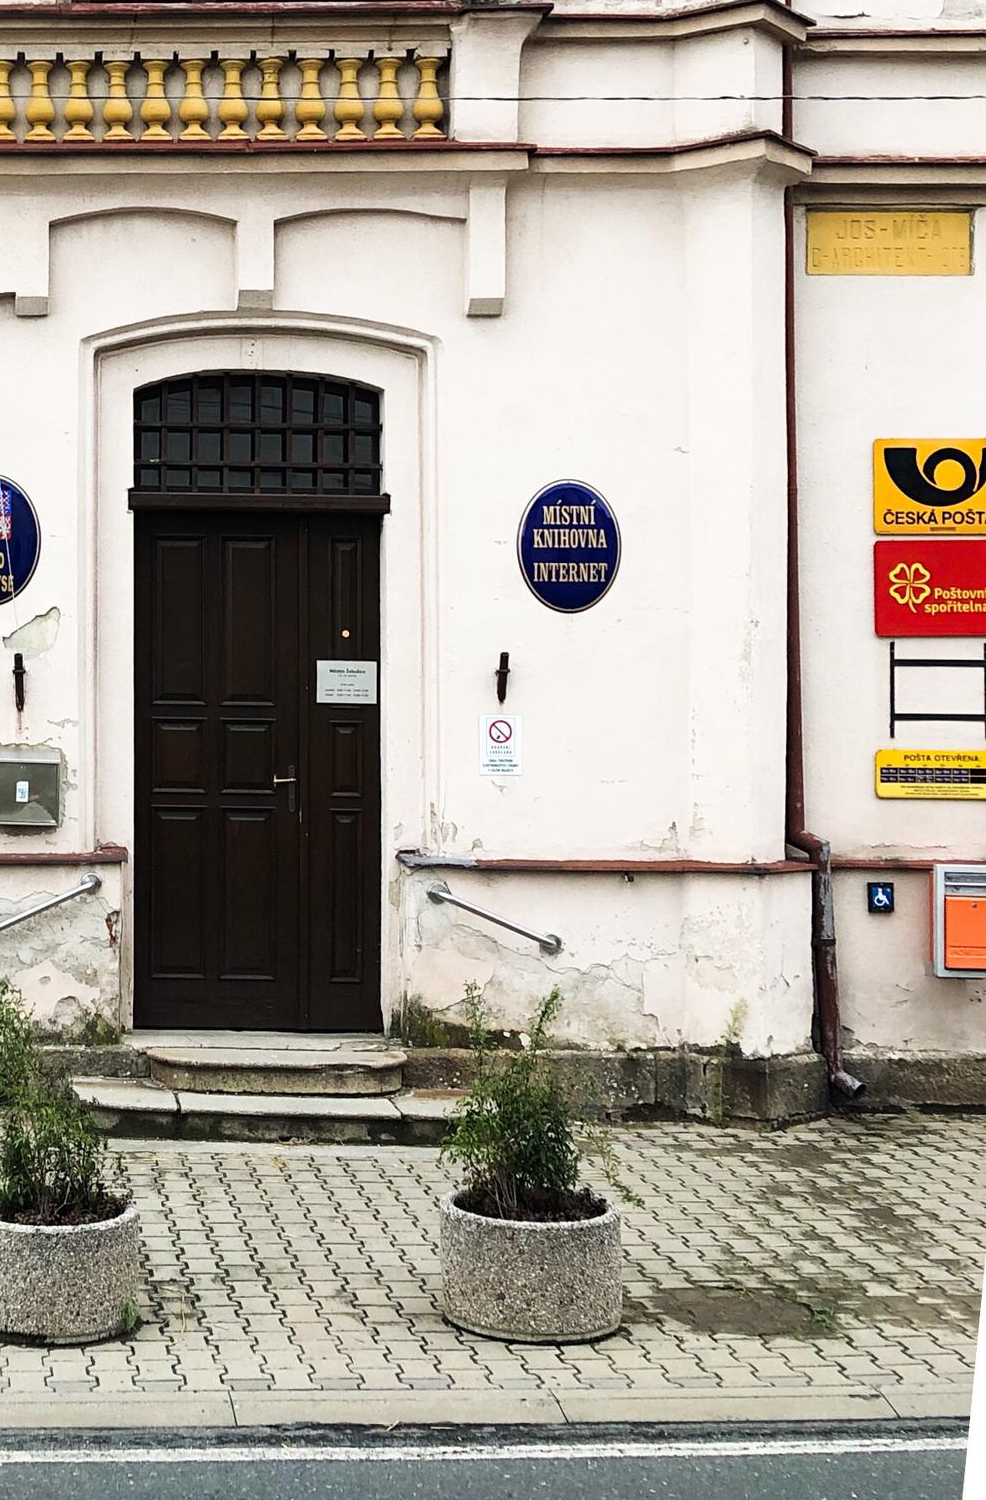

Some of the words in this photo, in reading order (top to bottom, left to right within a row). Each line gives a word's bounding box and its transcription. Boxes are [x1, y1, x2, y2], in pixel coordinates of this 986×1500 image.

[542, 499, 596, 525] MÍSTNÍ
[883, 508, 938, 525] ČESKÁ
[941, 508, 986, 525] POŠT
[533, 528, 608, 549] KNIHOVNA
[533, 562, 608, 583] INTERNET
[903, 753, 932, 762] POŠTA
